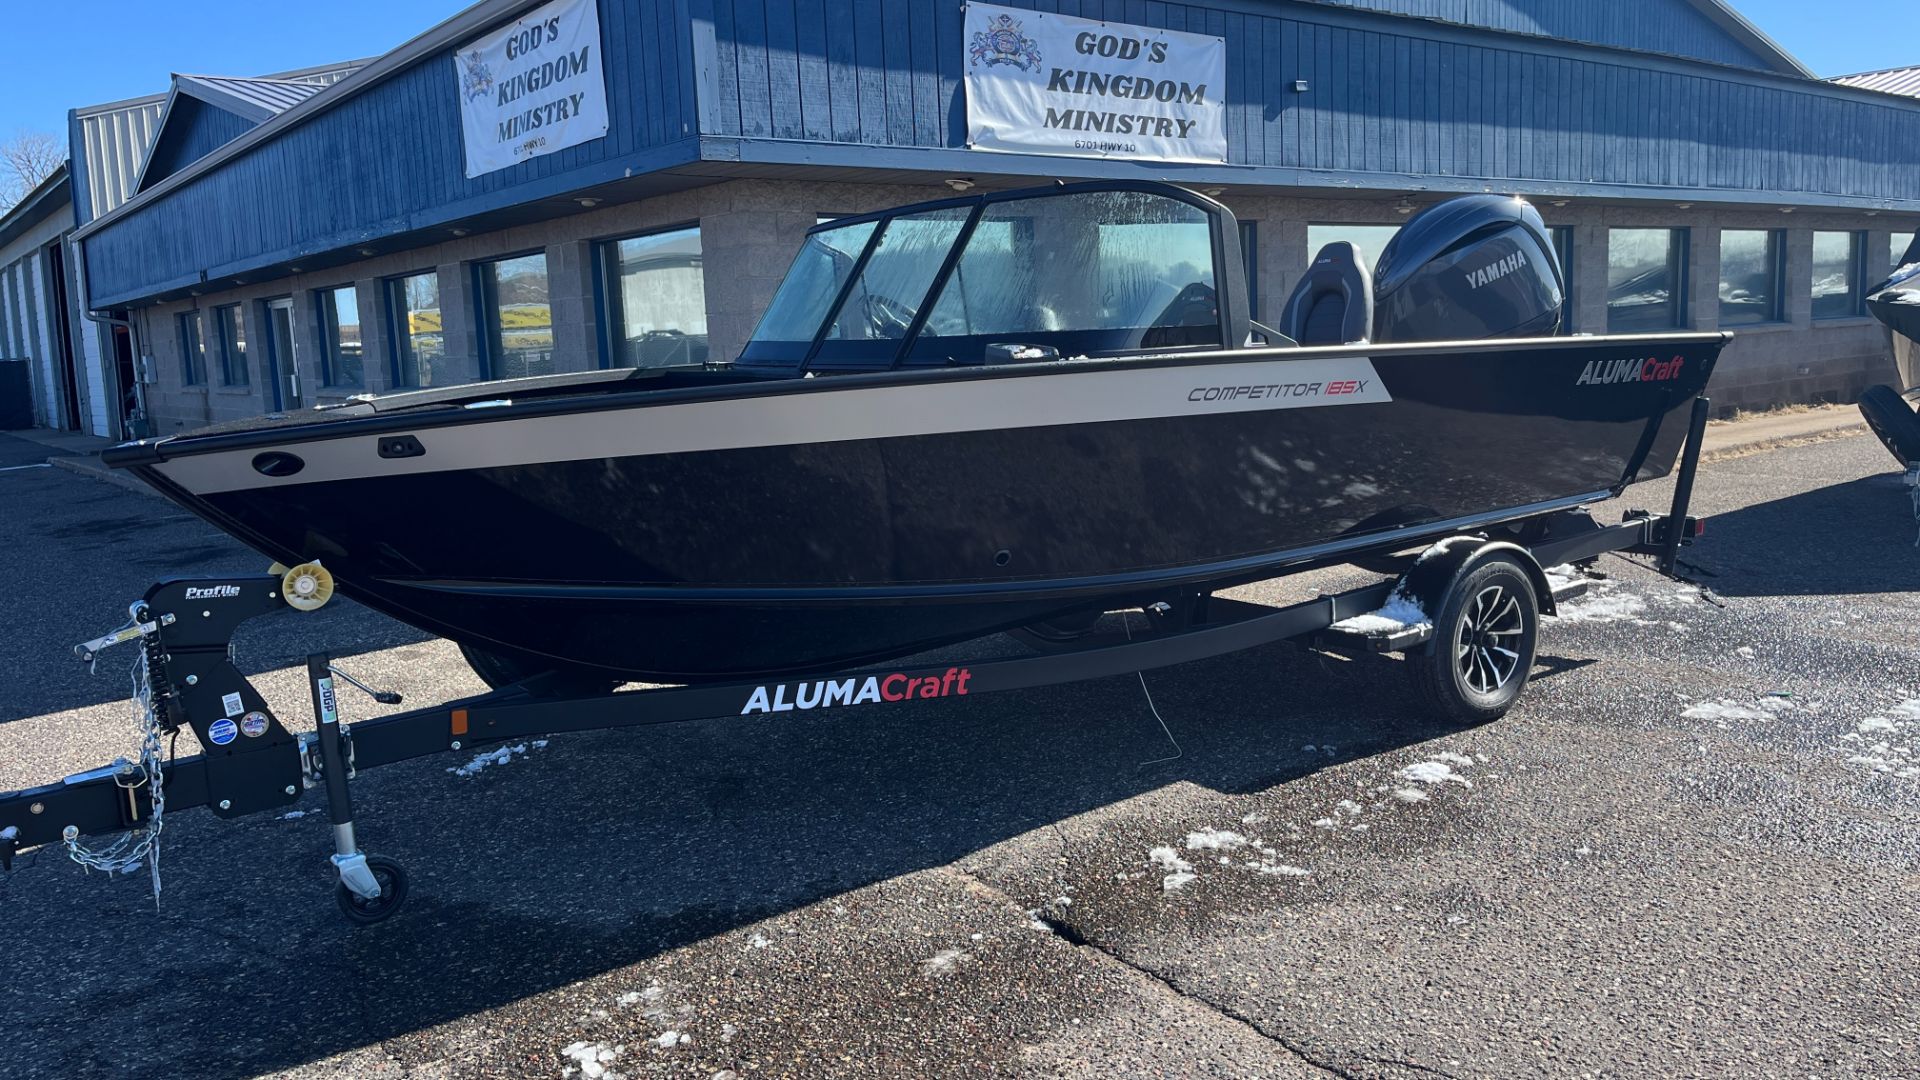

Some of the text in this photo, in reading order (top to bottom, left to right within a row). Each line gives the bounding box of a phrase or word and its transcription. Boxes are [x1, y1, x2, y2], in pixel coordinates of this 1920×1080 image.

[506, 16, 560, 61] GOD'S
[1075, 31, 1168, 63] GOD'S
[497, 45, 589, 107] KINGDOM
[1046, 68, 1207, 105] KINGDOM
[497, 91, 584, 144] MINISTRY
[1043, 107, 1196, 139] MINISTRY
[1074, 140, 1136, 153] 6701 HWY 10
[1465, 249, 1527, 290] YAMAHA
[1576, 355, 1684, 386] ALUMACraft
[1187, 382, 1322, 401] COMPETITOR
[185, 584, 241, 597] Profile
[740, 667, 972, 715] ALUMACraft
